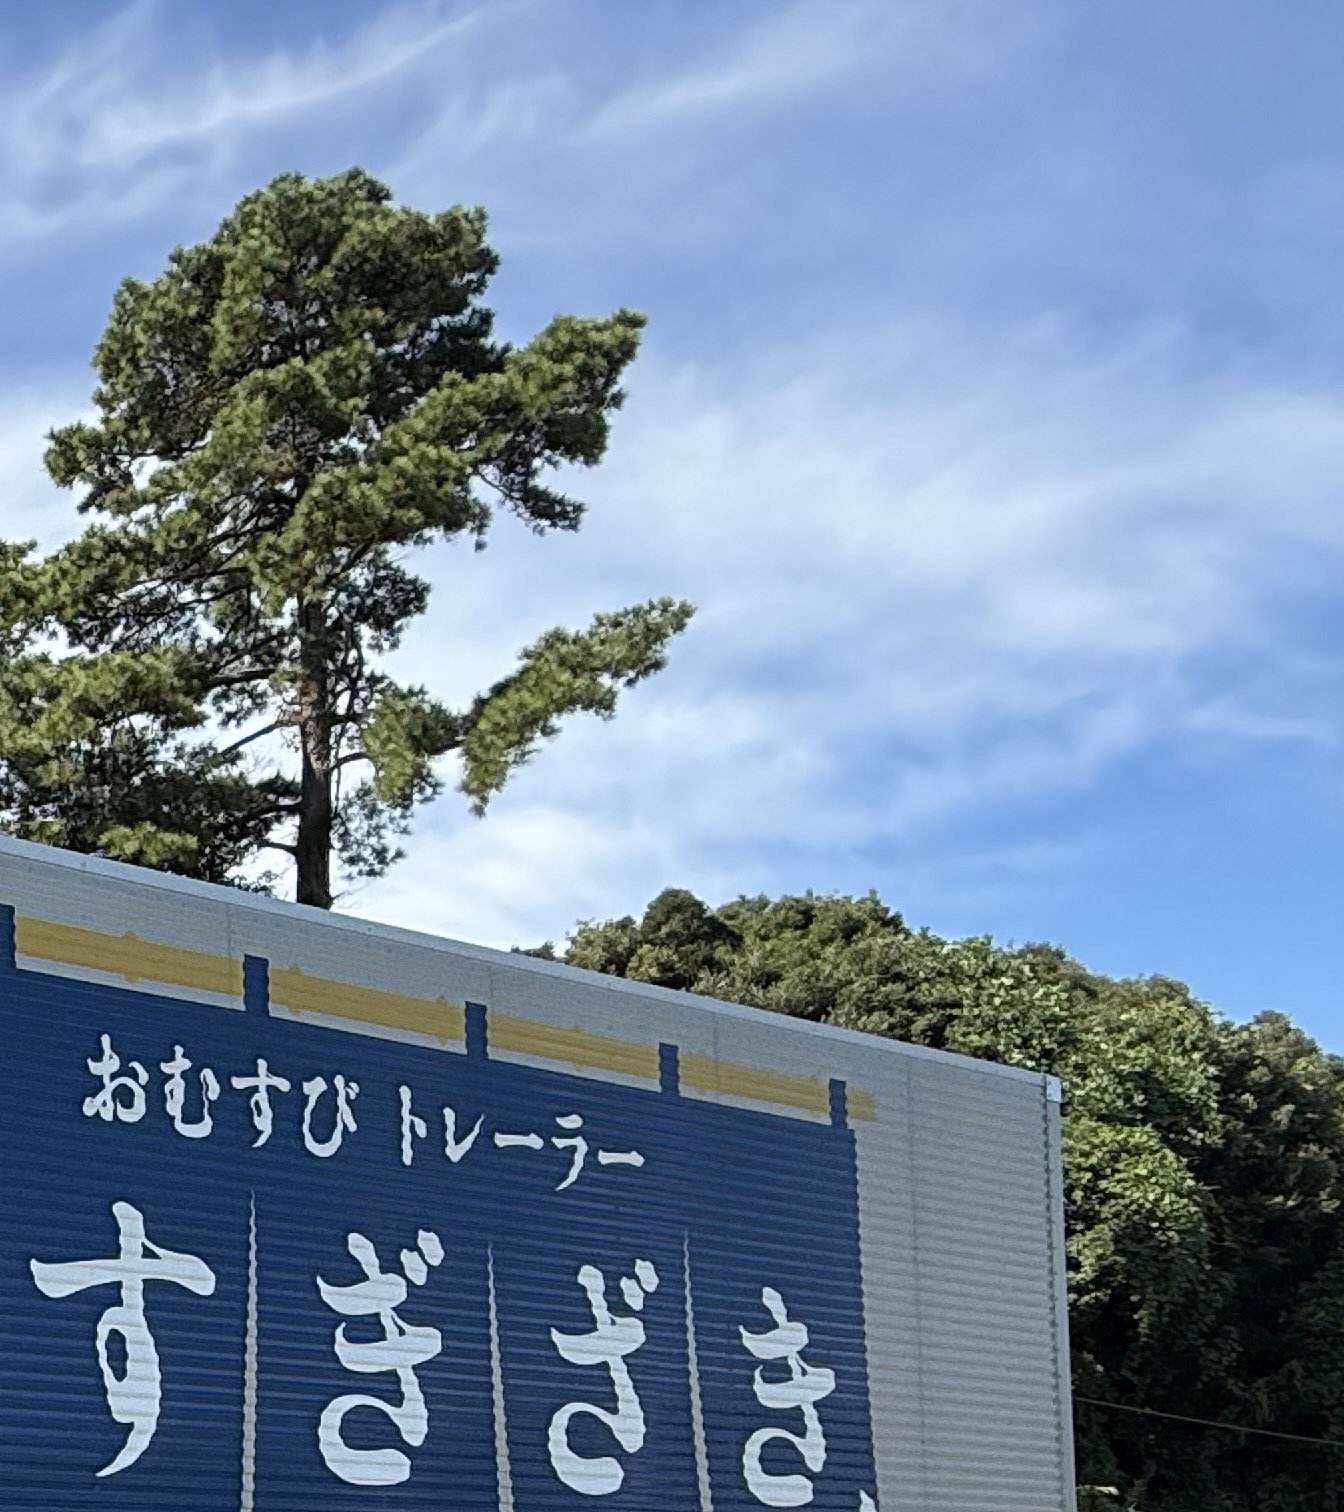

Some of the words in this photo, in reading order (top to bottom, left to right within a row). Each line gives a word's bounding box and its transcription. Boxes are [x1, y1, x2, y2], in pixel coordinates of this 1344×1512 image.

[83, 1033, 359, 1159] おむすび
[399, 1084, 646, 1192] トレーラー
[29, 1200, 836, 1508] すぎざき
